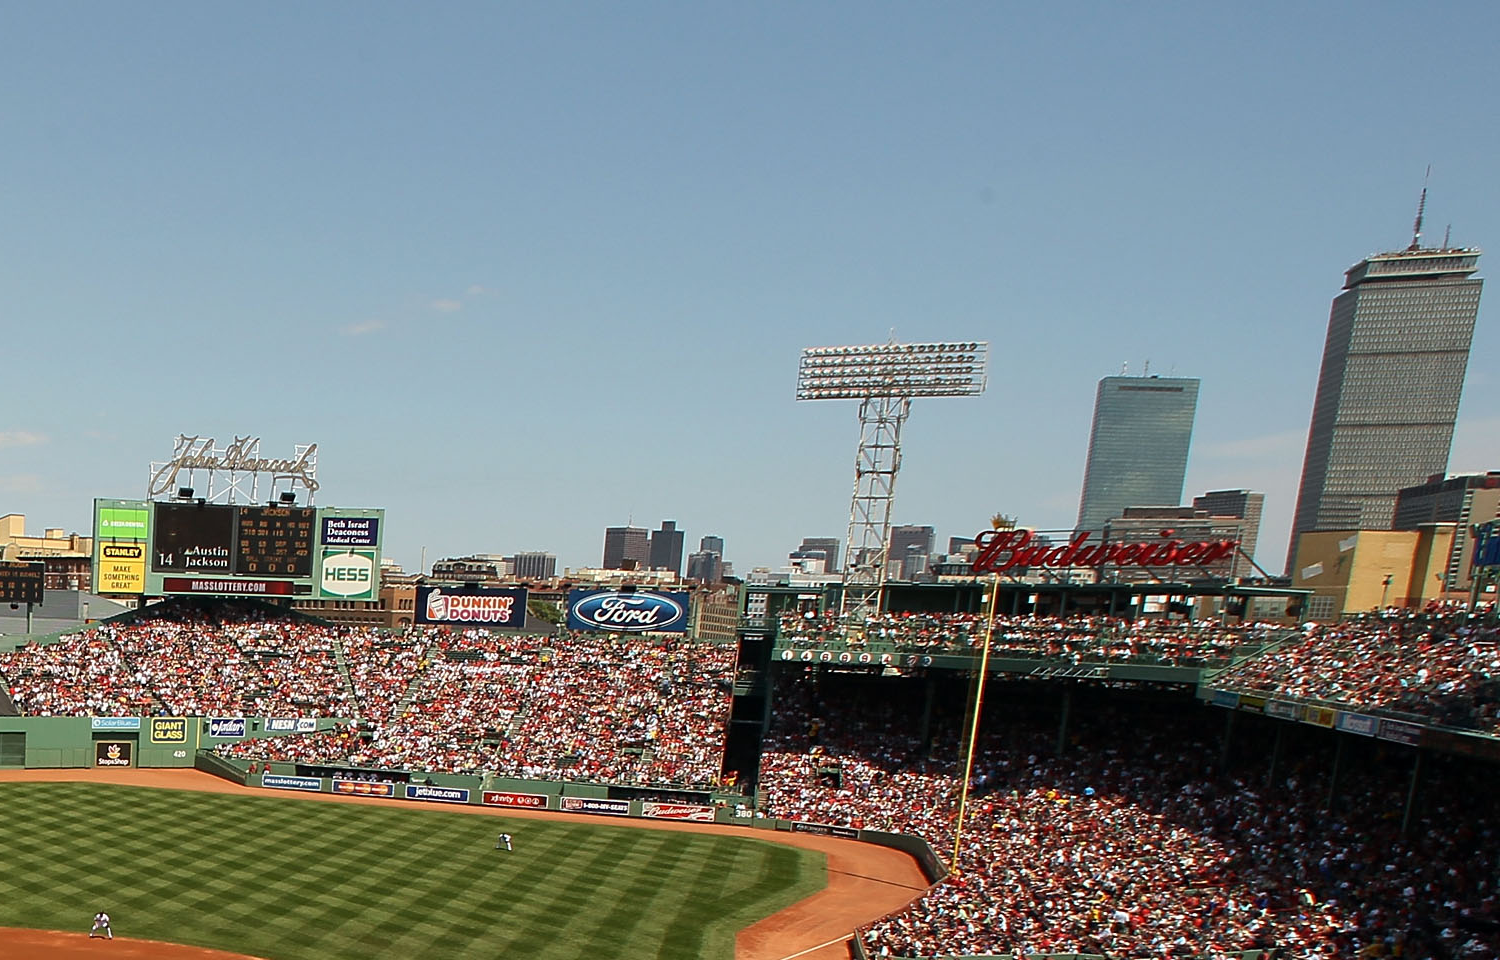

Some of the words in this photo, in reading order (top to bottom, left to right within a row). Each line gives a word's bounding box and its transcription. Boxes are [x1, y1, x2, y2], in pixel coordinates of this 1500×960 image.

[327, 520, 344, 529] Beth
[347, 521, 369, 530] Israel
[106, 548, 140, 556] STANLEY
[192, 546, 228, 556] Austin
[973, 528, 1241, 572] Budweiser
[159, 553, 173, 566] 14
[185, 556, 228, 567] Jackson
[324, 567, 369, 582] HESS
[191, 580, 266, 592] MASSLOTTERY.COM
[450, 596, 514, 610] DUNKIN'
[449, 609, 512, 622] DONUTS
[594, 598, 661, 624] Ford
[155, 722, 183, 730] GIANT
[271, 719, 295, 730] NESN
[154, 731, 183, 739] GLASS
[264, 777, 319, 788] masslottery.com
[414, 786, 461, 799] jetblue.com
[649, 805, 702, 818] Budweiser
[735, 810, 752, 818] 380
